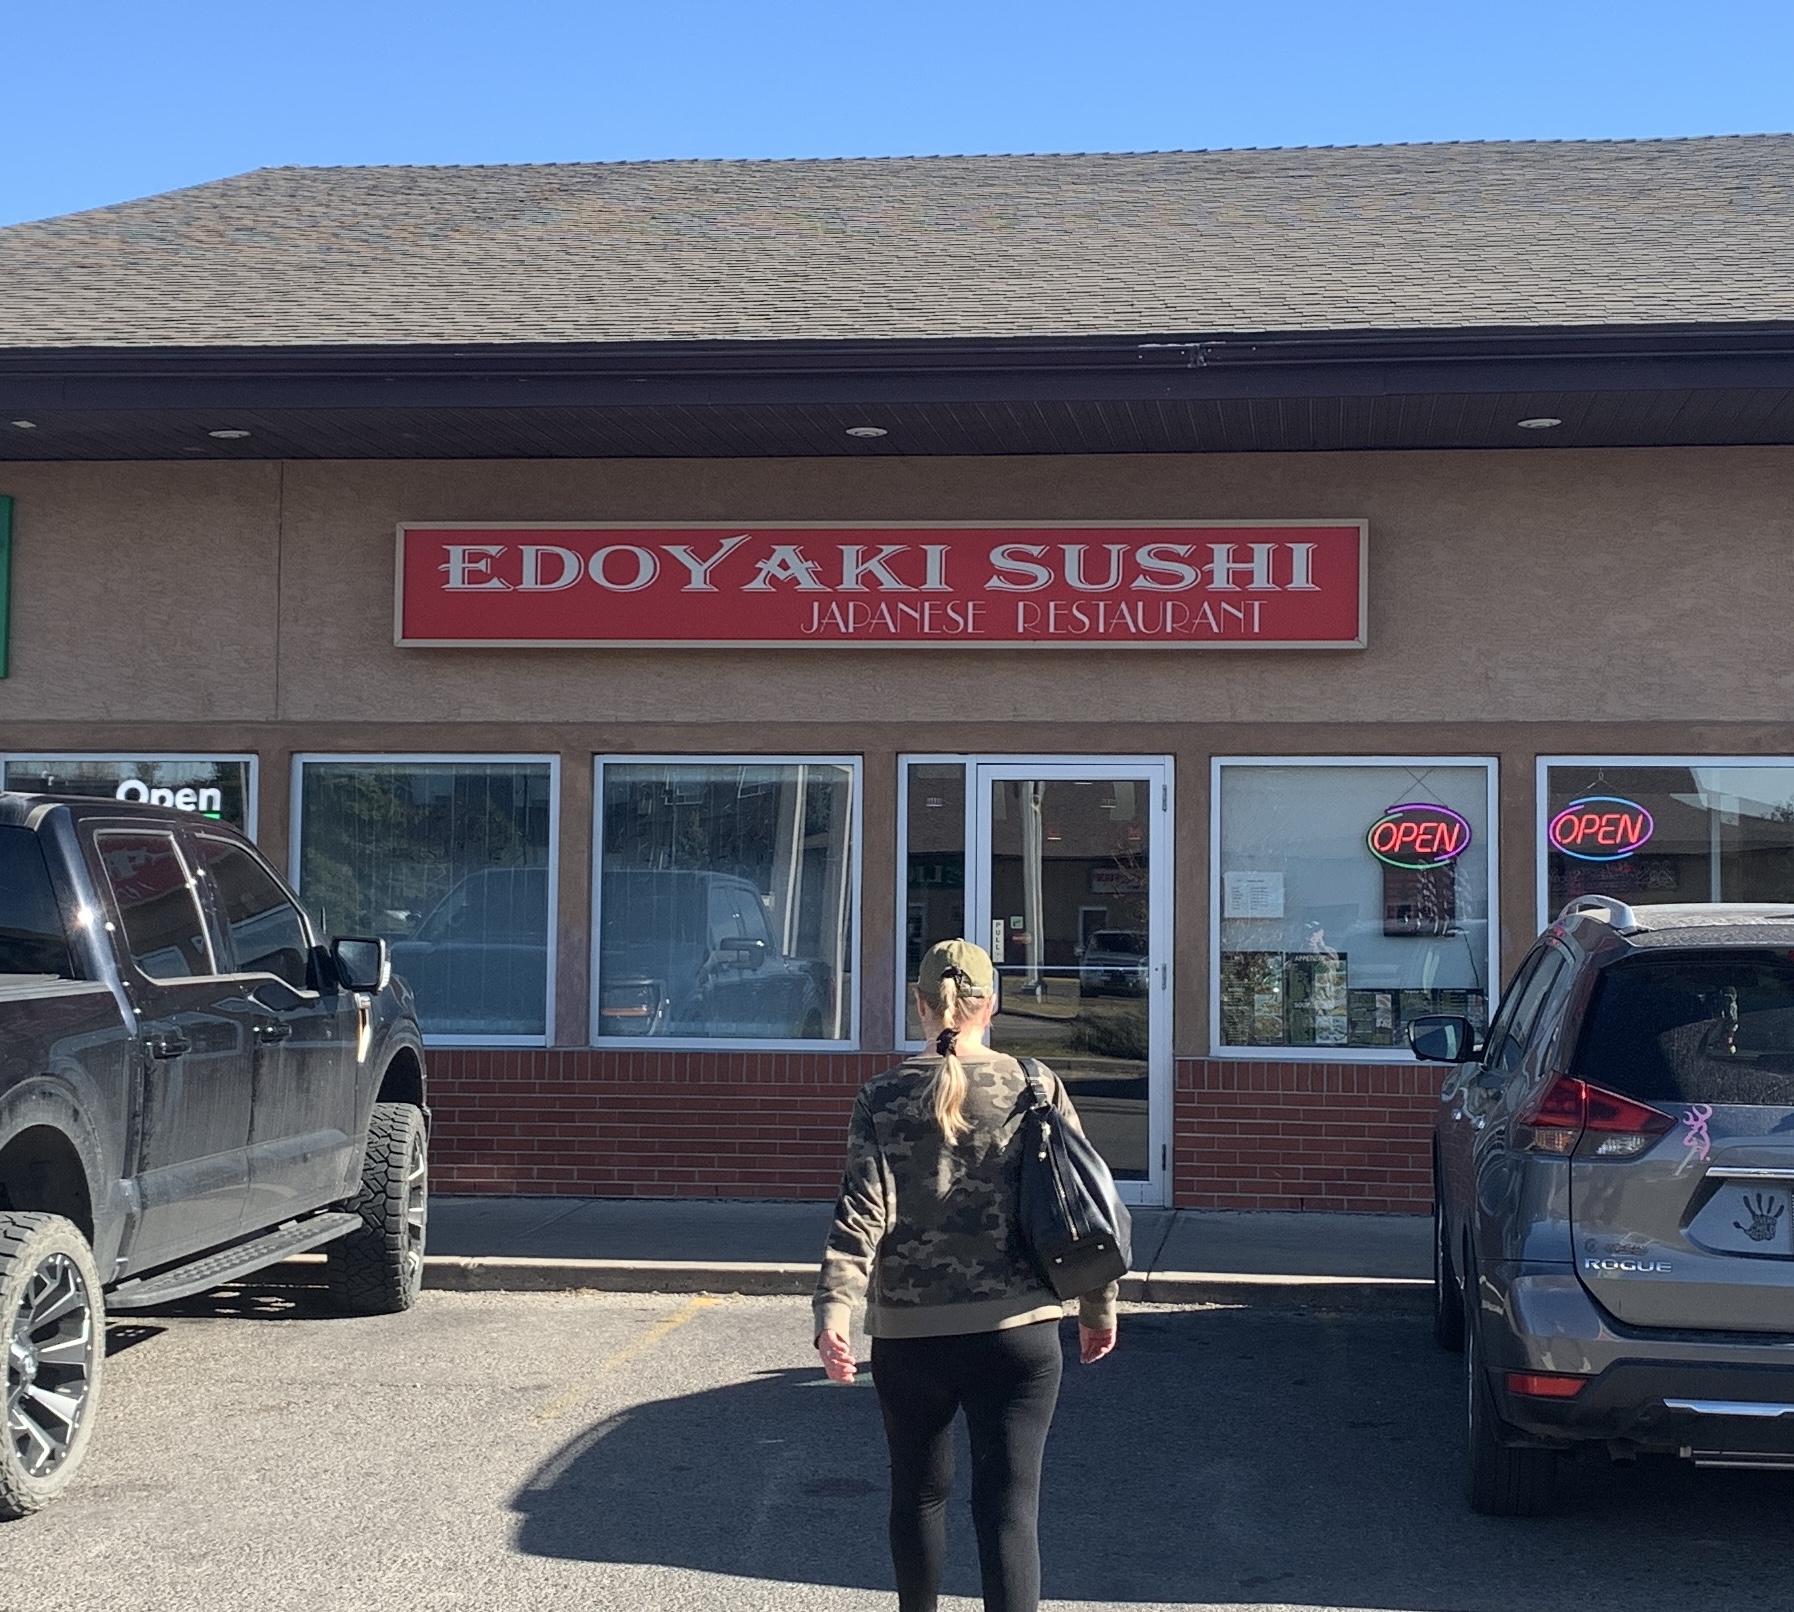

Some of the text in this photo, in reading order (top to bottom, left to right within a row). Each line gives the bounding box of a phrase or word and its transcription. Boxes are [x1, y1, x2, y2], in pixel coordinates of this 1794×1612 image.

[438, 533, 1323, 592] EDOYAKI SUSHI
[800, 600, 1268, 634] JAPANESE RESTAURANT
[1373, 822, 1460, 853] OPEN
[1555, 813, 1643, 845] OPEN
[1585, 1258, 1672, 1273] ROGUE
